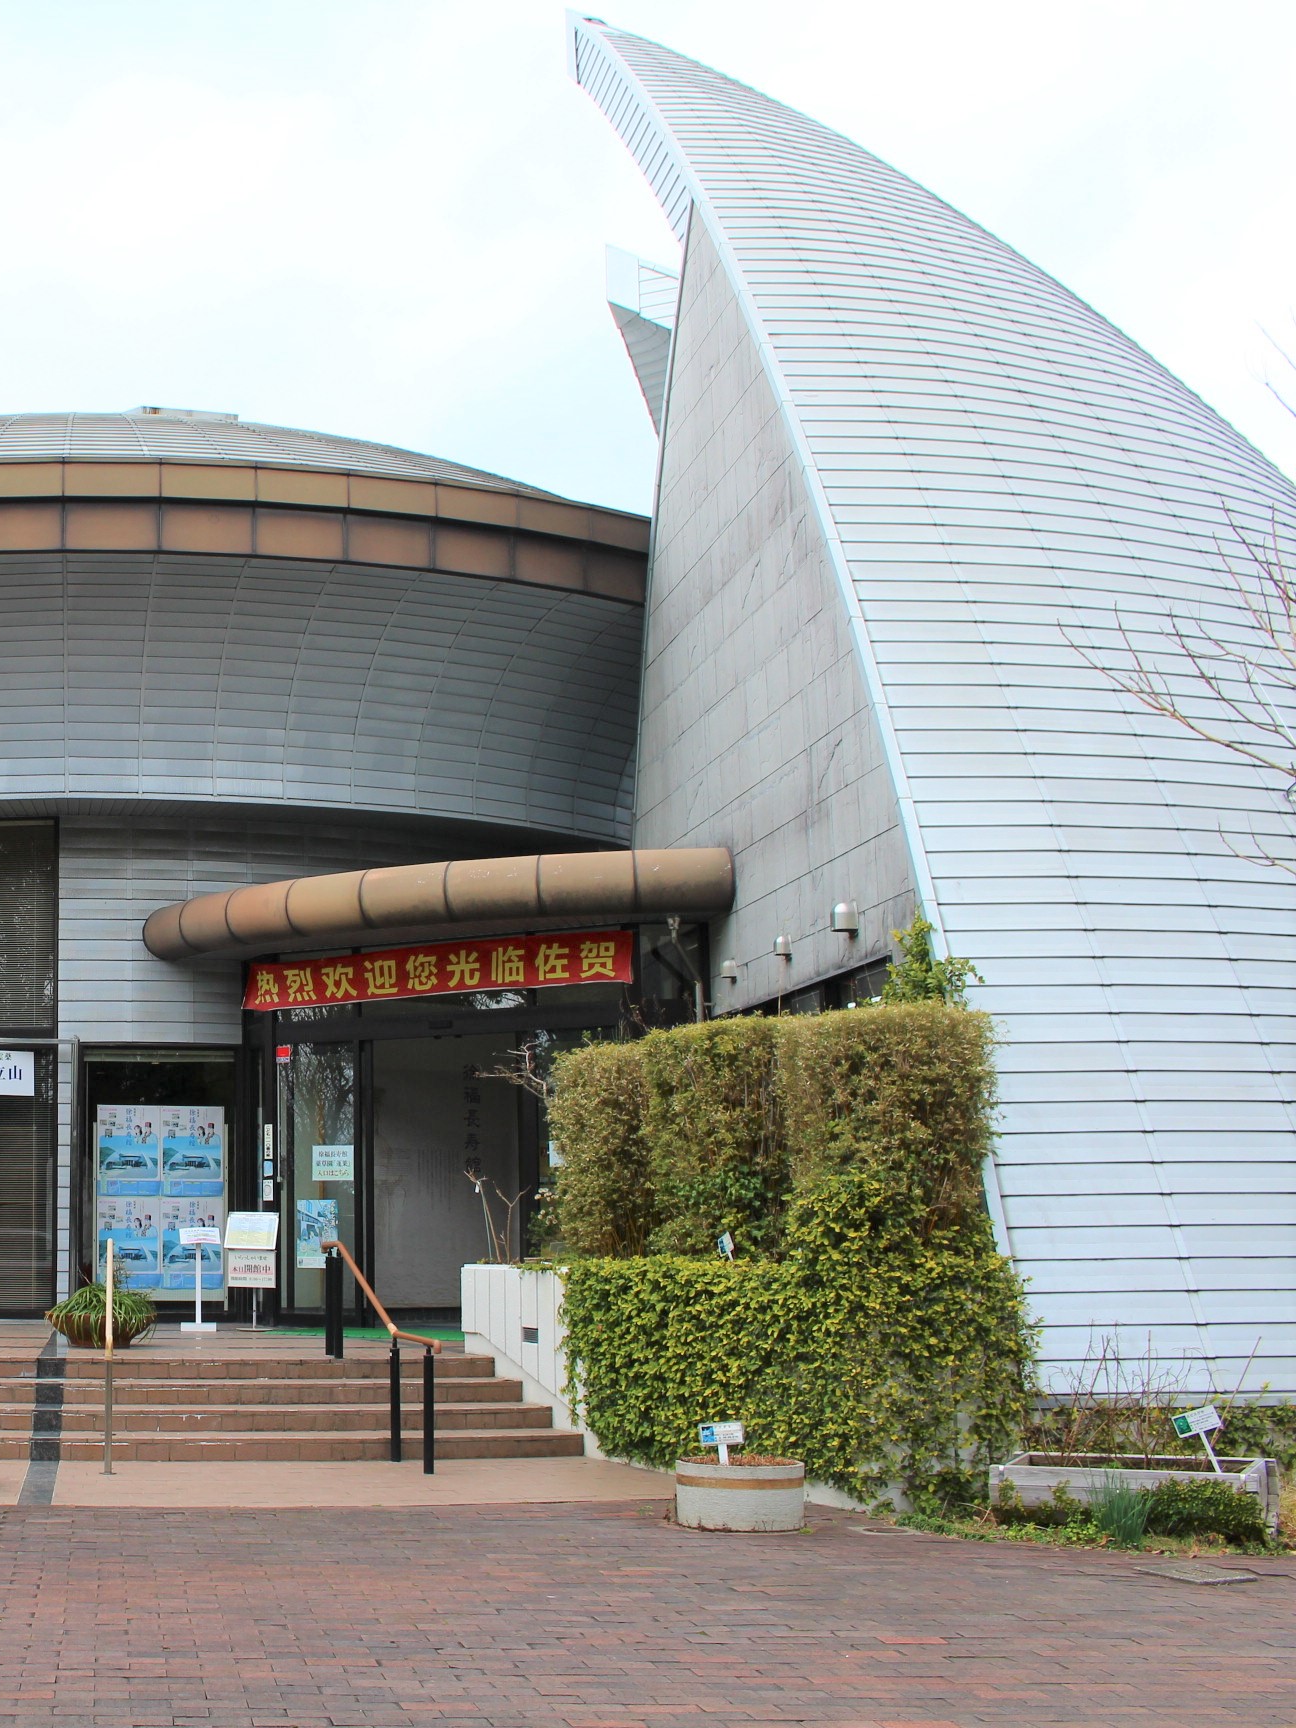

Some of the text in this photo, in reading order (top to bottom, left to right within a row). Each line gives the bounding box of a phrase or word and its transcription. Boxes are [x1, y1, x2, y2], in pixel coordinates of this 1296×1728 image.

[254, 941, 616, 1005] 热烈欢迎您光临佐贺
